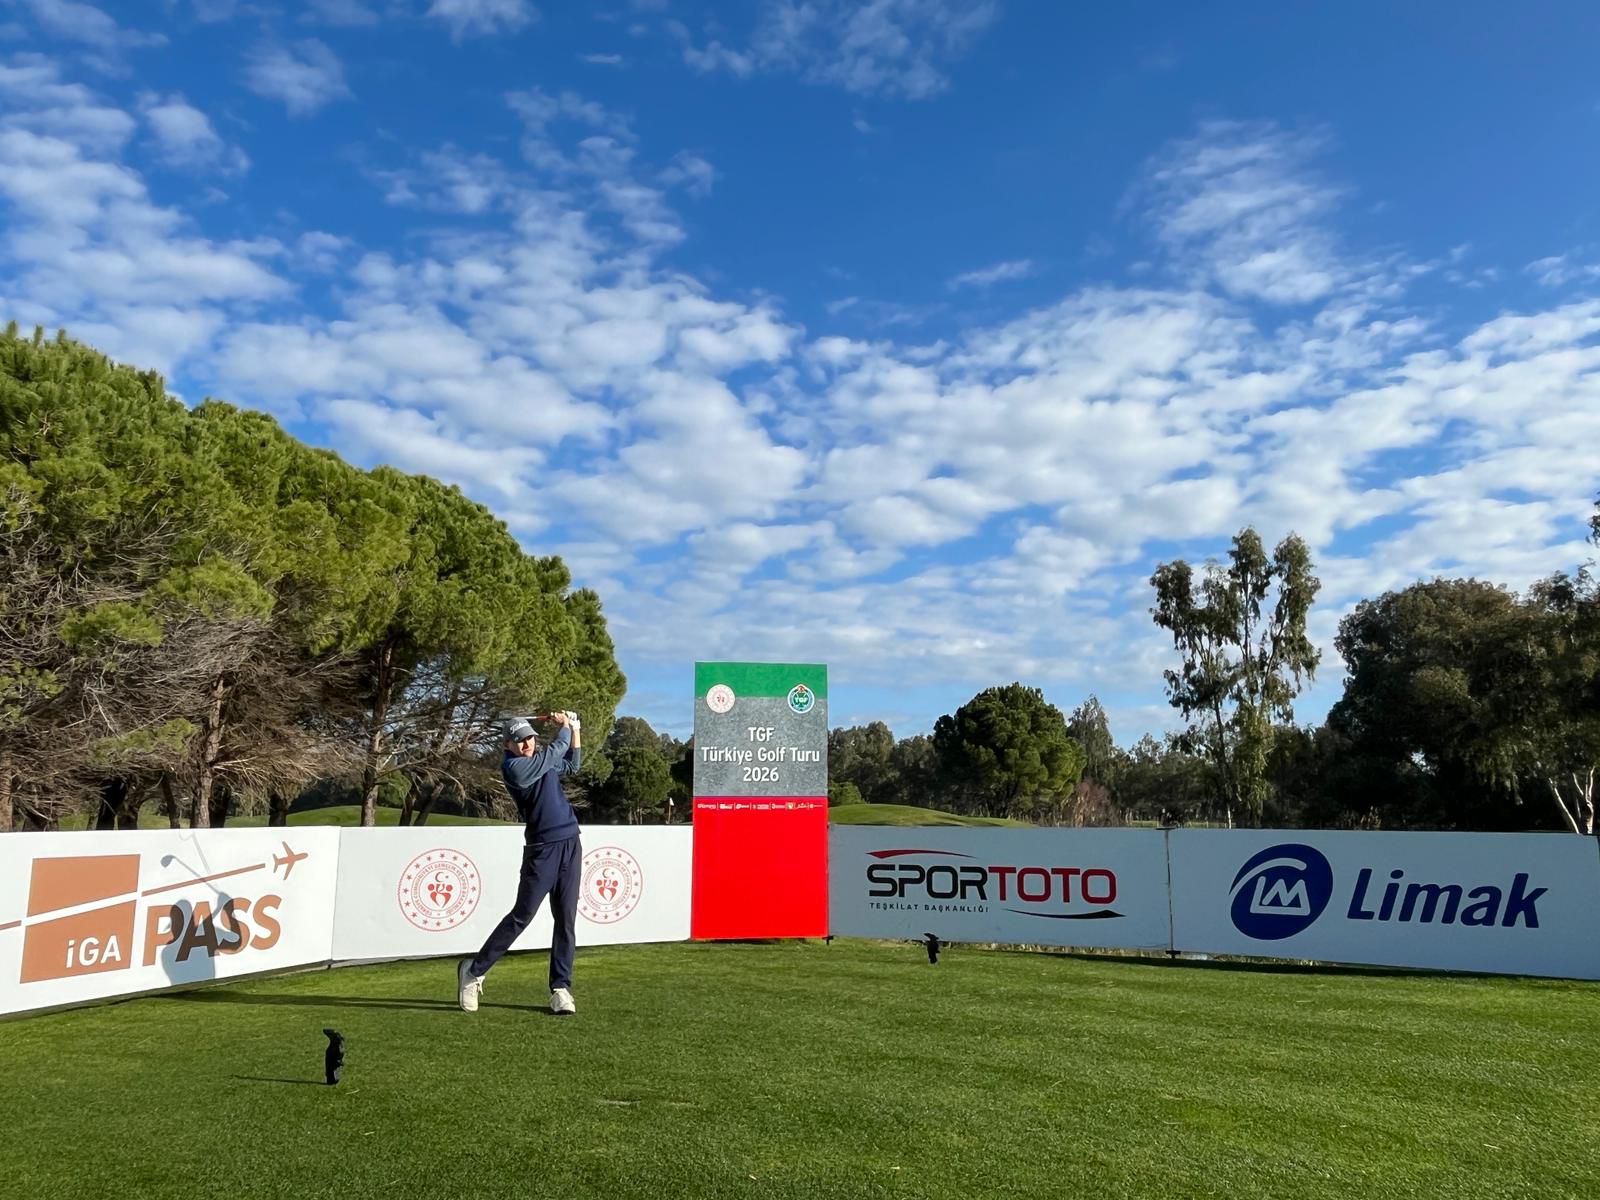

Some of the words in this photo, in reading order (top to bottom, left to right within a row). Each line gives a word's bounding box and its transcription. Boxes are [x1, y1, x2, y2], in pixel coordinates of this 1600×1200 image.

[747, 727, 775, 742] TGF
[701, 747, 753, 765] Türkiye
[757, 747, 786, 762] Golf
[789, 747, 820, 762] Turu
[743, 767, 779, 782] 2026
[869, 902, 918, 911] TEŞKİLAT
[924, 904, 989, 913] BAŞKANLIĞI
[1347, 868, 1548, 929] Limak
[142, 894, 282, 967] PASS
[65, 935, 121, 969] iGA
